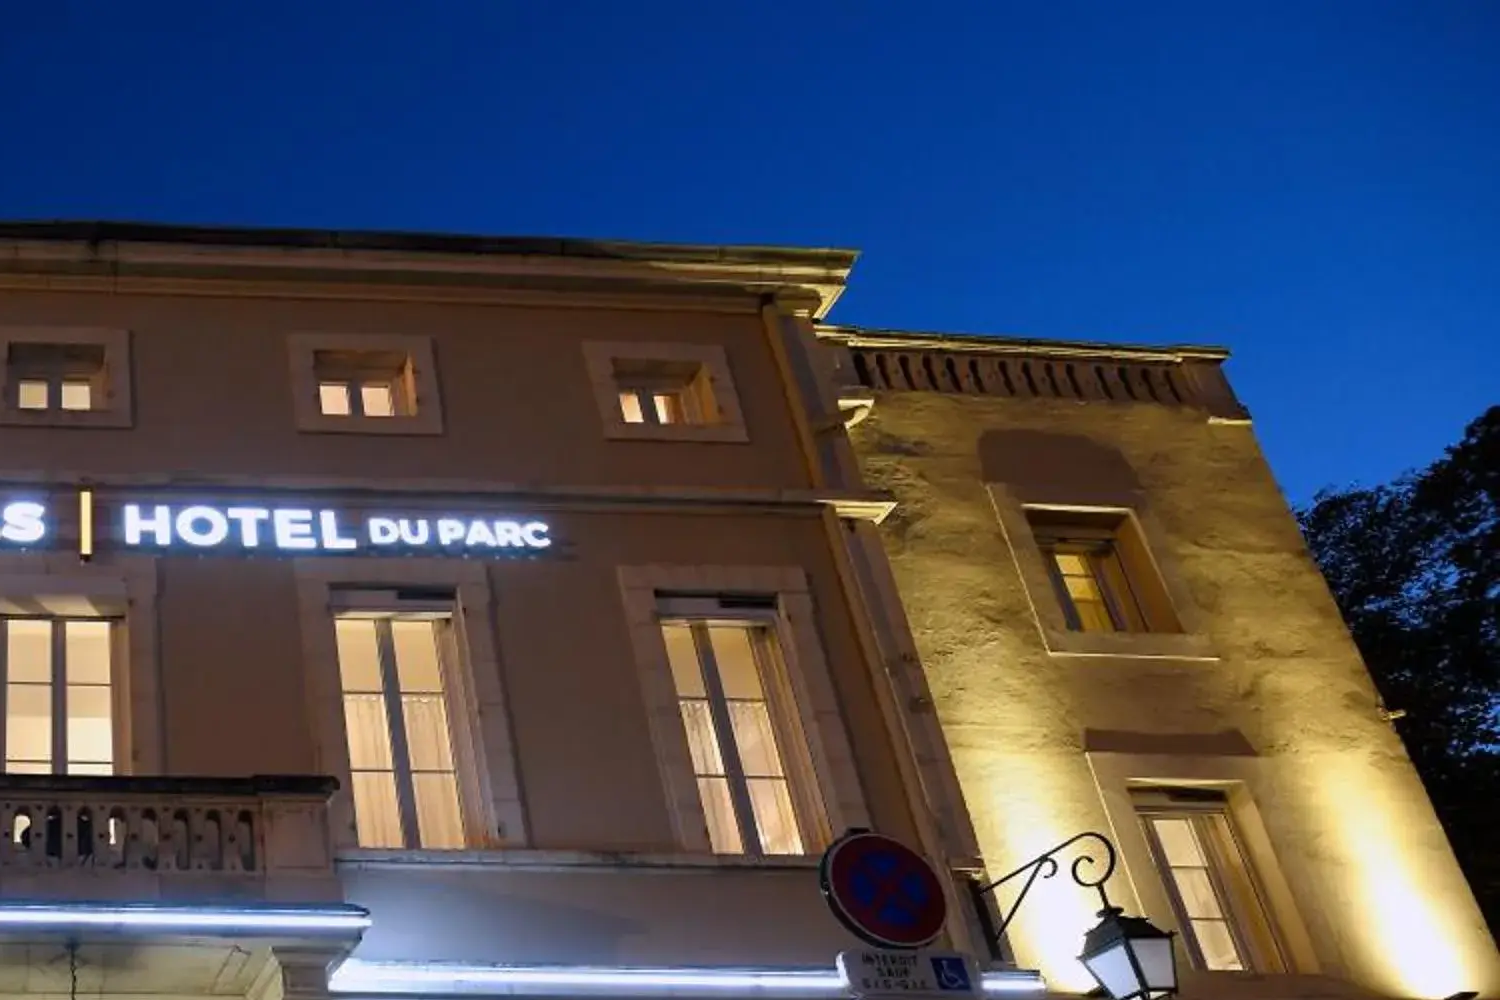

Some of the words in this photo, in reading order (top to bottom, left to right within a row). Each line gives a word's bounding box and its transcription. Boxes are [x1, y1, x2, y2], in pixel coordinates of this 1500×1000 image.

[124, 504, 357, 550] HOTEL
[368, 517, 429, 545] DU
[437, 519, 551, 548] PARC
